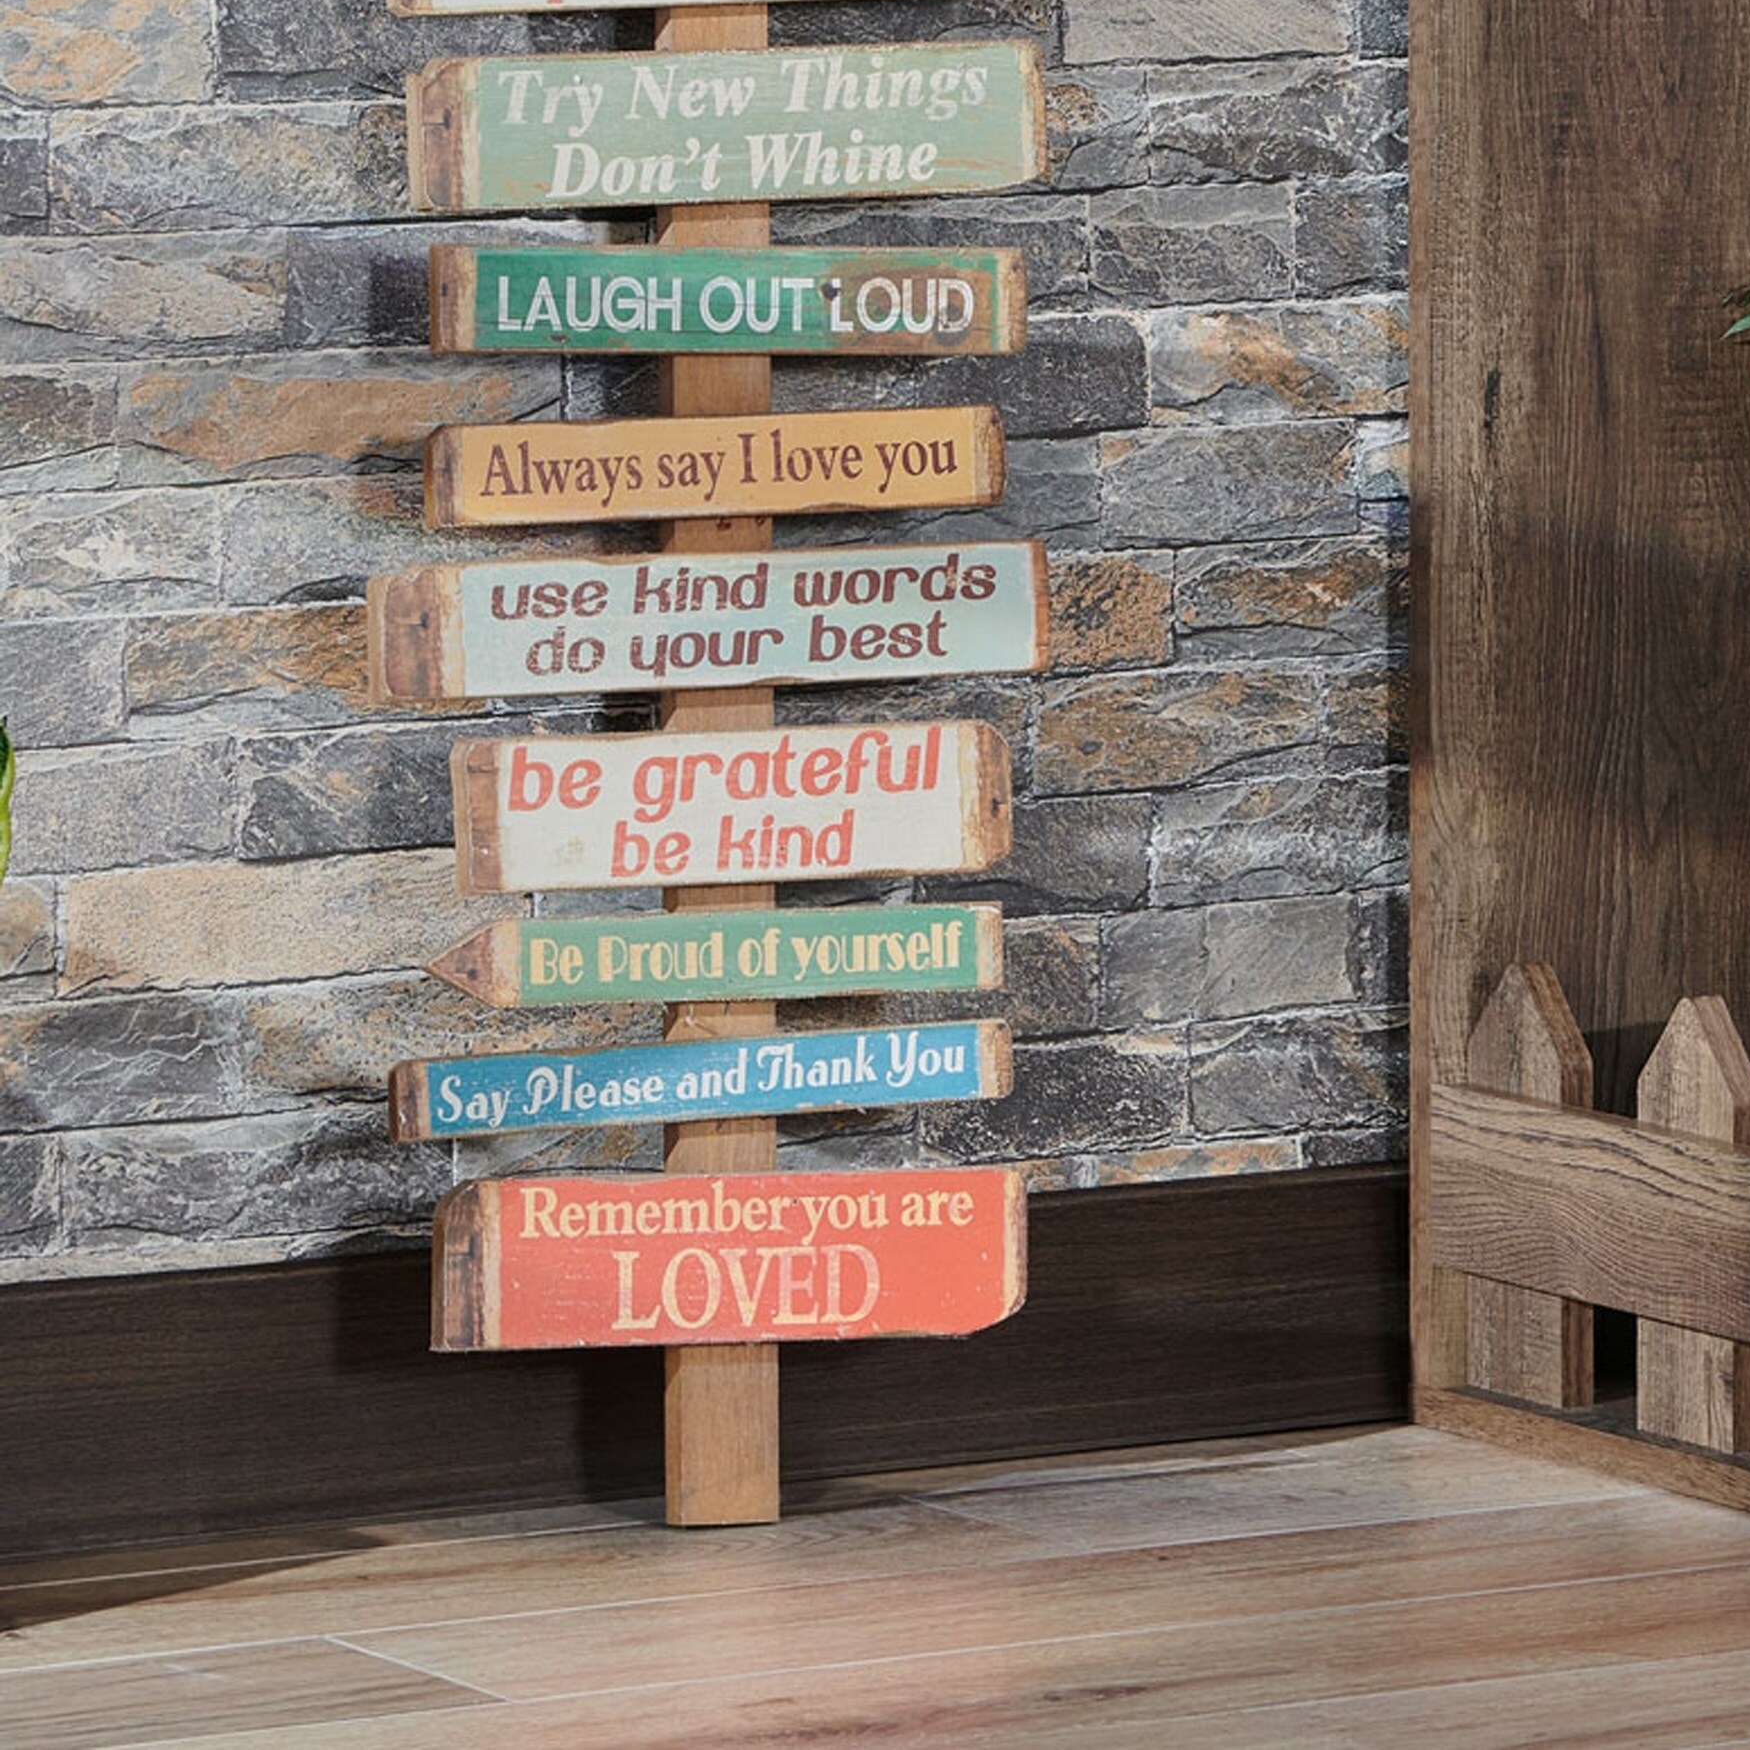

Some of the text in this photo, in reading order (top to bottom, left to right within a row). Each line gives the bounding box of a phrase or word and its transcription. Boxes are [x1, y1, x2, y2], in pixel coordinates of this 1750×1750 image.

[497, 56, 988, 130] Try New Things
[546, 129, 939, 200] Don't Whine
[497, 274, 975, 334] LAUGH OUT LOUD
[479, 428, 958, 508] Always say I love you
[490, 552, 998, 621] use kind words
[525, 609, 949, 677] do your best
[506, 725, 941, 824] be grateful
[609, 809, 855, 878] be kind
[528, 921, 963, 985] Be Proud of yourself
[436, 1029, 966, 1127] Say Please and Thank You
[519, 1179, 975, 1247] Remember you are
[610, 1243, 882, 1331] LOVED
